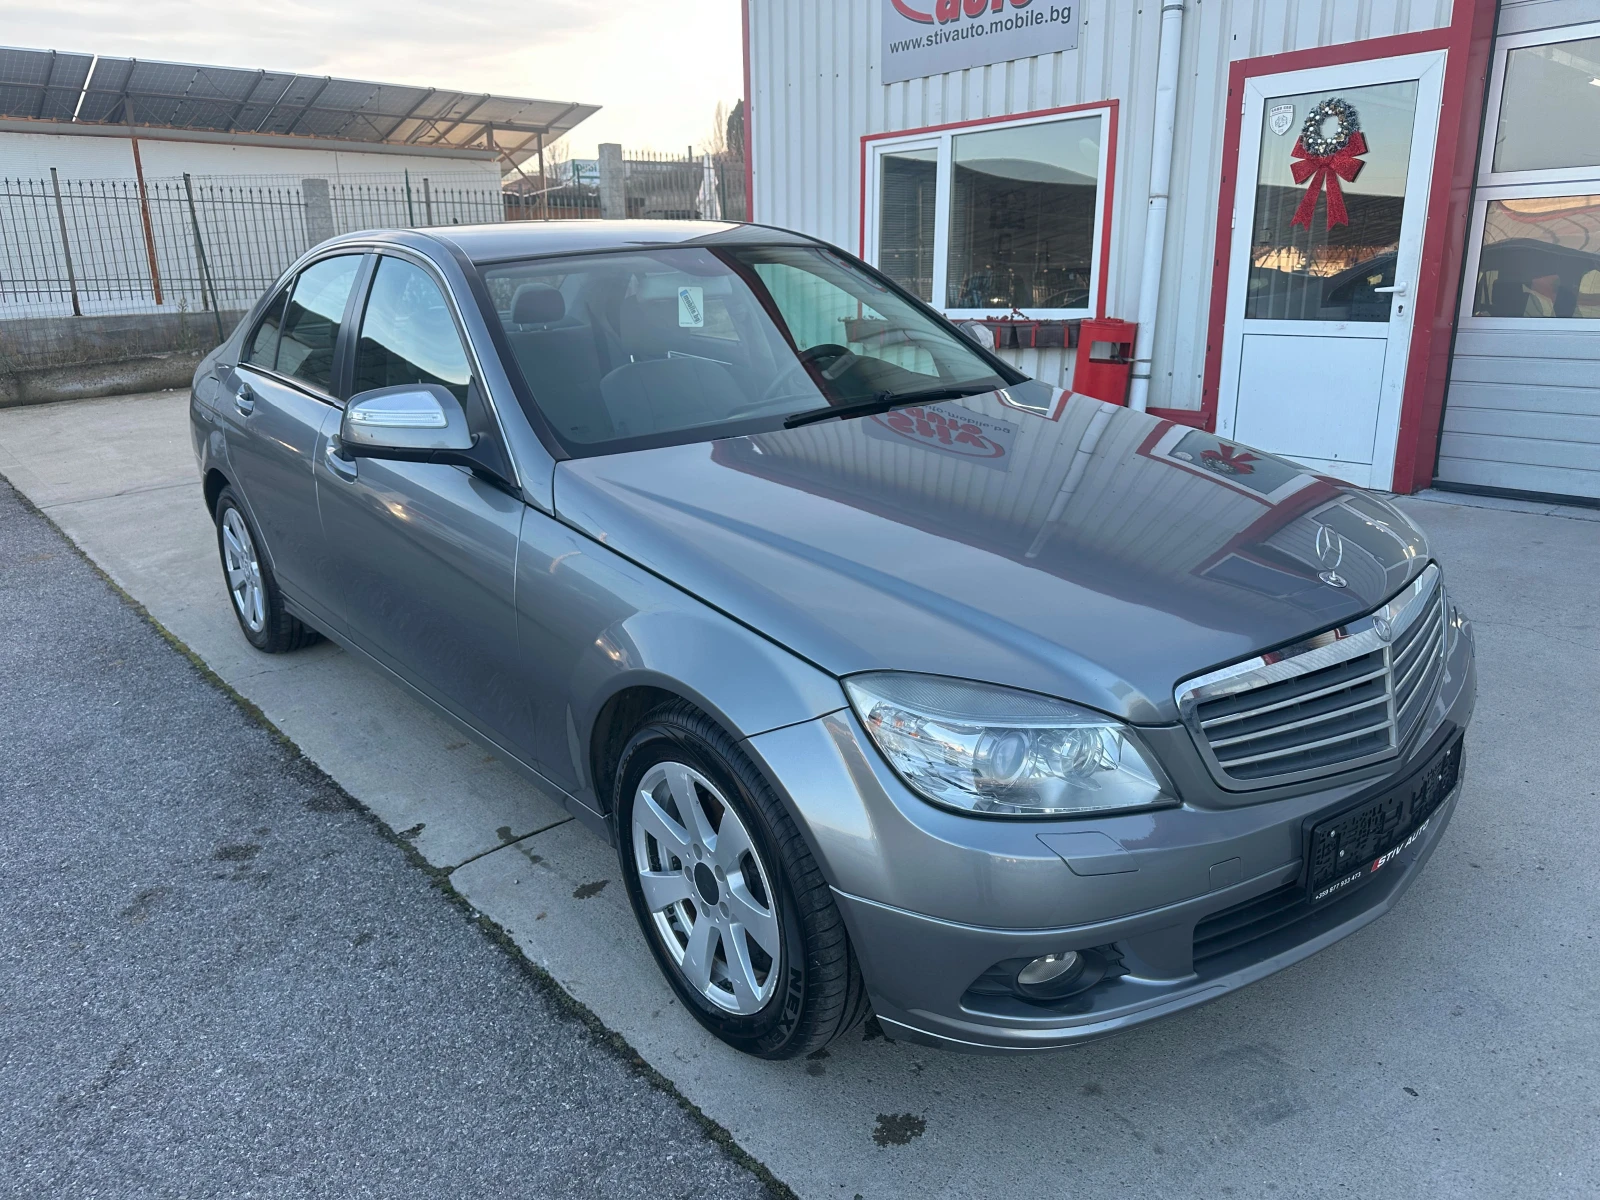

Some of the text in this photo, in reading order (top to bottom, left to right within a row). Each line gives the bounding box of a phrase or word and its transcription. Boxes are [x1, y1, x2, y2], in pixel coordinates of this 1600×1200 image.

[889, 5, 1072, 53] www.stivauto.mobile.bg
[1377, 818, 1430, 868] STIV AUTO
